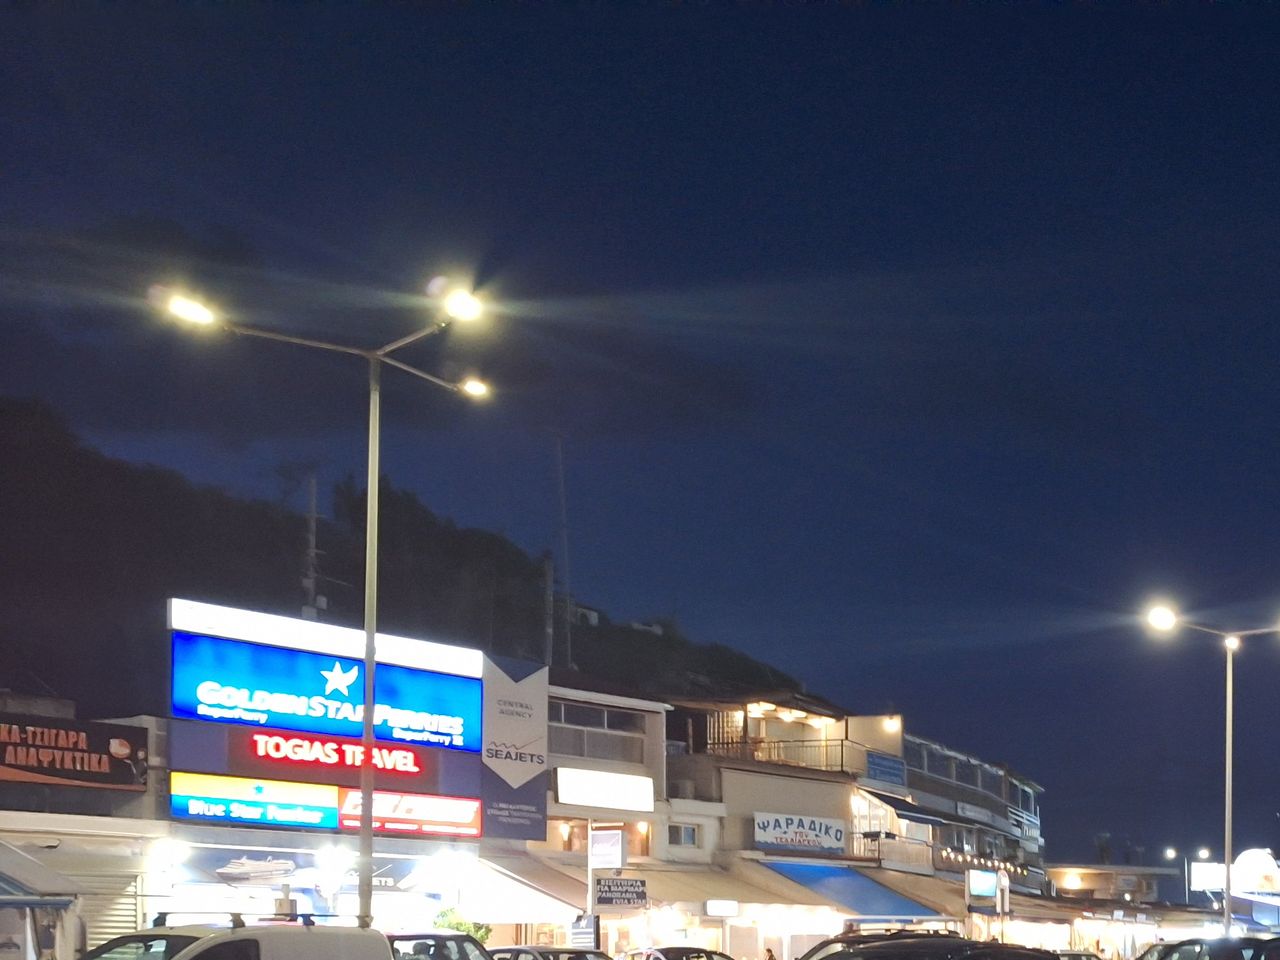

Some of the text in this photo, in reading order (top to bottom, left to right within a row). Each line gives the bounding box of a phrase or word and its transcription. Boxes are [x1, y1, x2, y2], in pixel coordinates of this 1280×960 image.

[196, 681, 308, 716] GOLDEN
[497, 699, 533, 711] CENTRAL
[499, 709, 534, 719] AGENCY
[5, 745, 111, 774] ΑΝΑΨΥΚΤΙΚΑ
[253, 734, 339, 763] TOGIAS
[486, 748, 544, 765] SEAJETS
[188, 799, 226, 816] Blue
[229, 802, 264, 819] Star
[757, 817, 843, 842] ΨΑΡΑΔΙΚΟ
